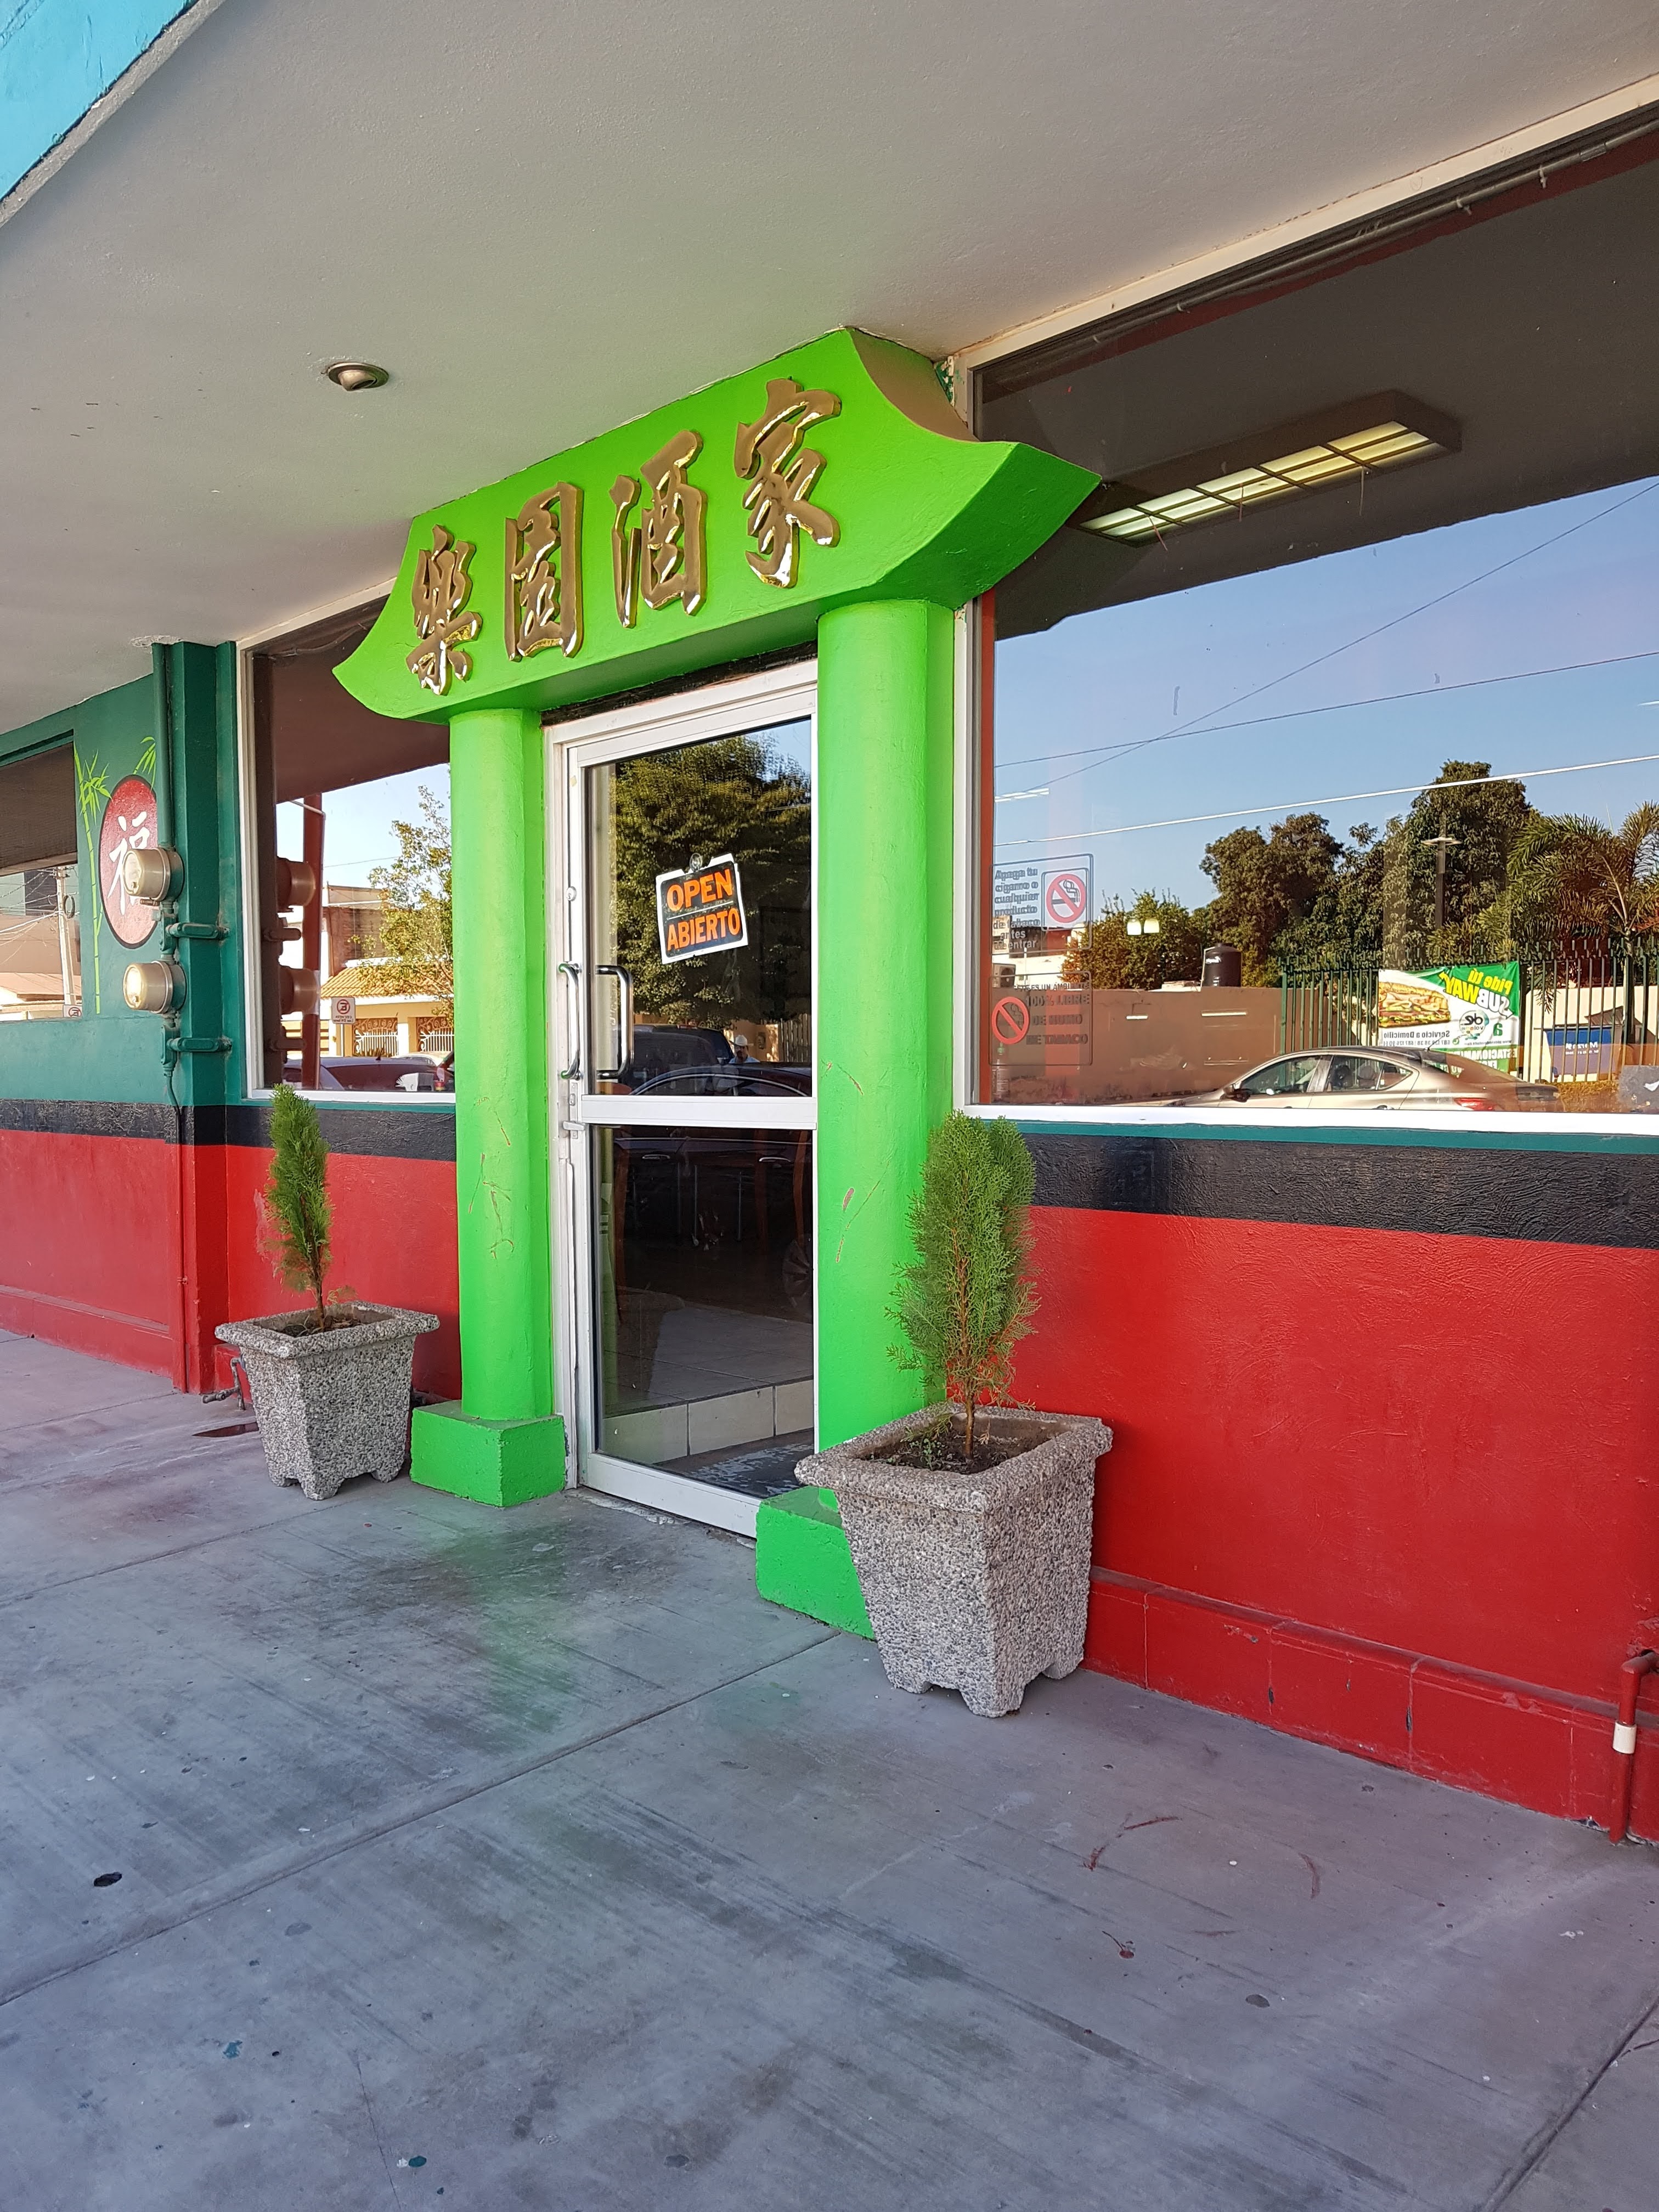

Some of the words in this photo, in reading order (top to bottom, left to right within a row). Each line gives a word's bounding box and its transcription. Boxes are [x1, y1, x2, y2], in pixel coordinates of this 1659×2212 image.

[995, 870, 1025, 881] Apaga
[1027, 867, 1038, 876] tu
[667, 868, 733, 912] OPEN
[995, 891, 1040, 904] cualquier
[995, 905, 1037, 918] producto
[667, 907, 741, 951] ABIERTO
[993, 920, 1006, 929] de
[1007, 918, 1041, 928] tabaco
[1000, 930, 1026, 940] antes
[1009, 939, 1036, 950] entrar
